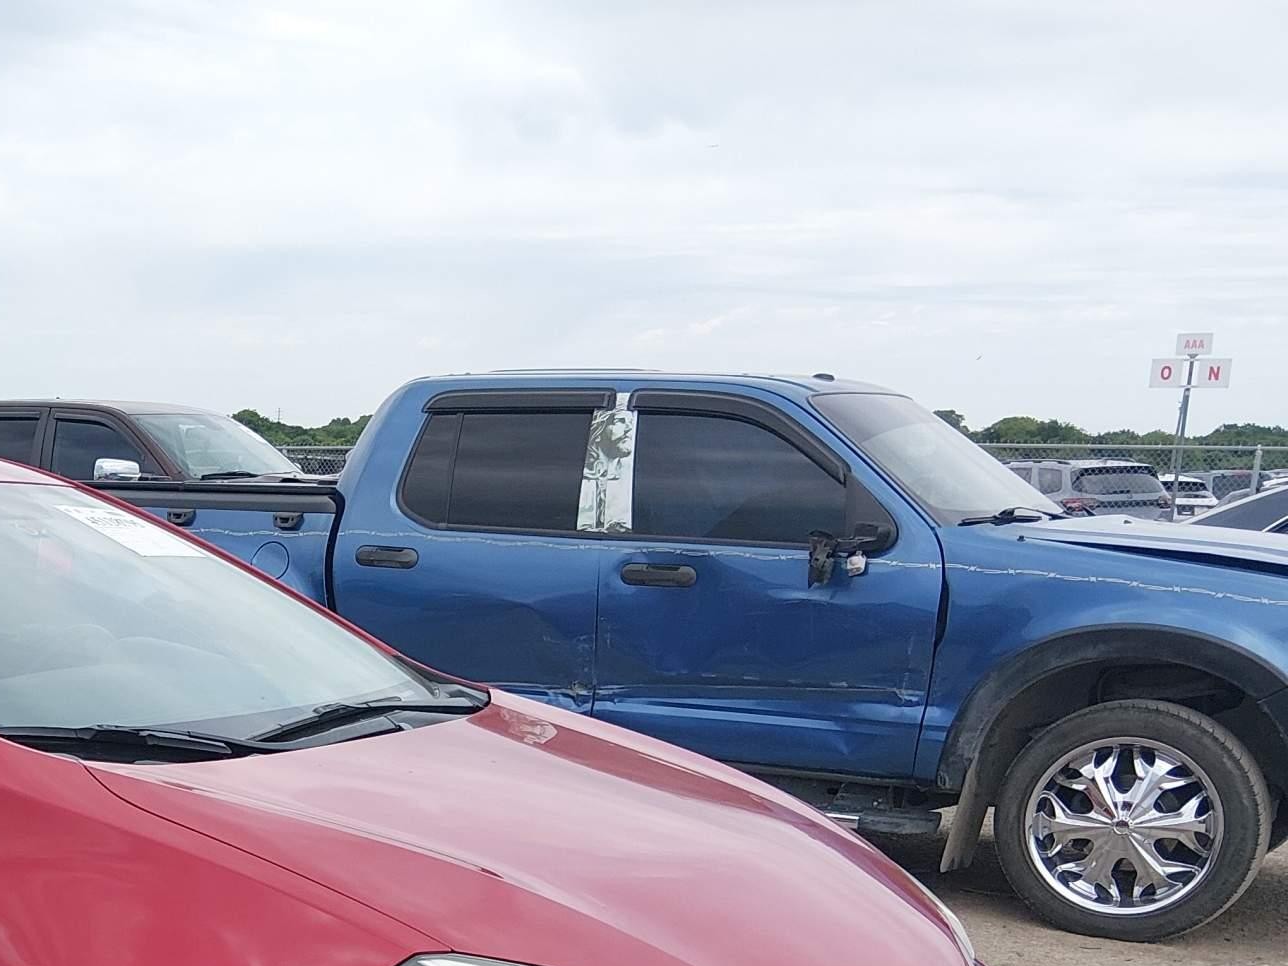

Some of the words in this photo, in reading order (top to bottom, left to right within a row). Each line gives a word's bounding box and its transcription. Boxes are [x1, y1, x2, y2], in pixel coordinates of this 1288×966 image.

[1184, 339, 1205, 350] AAA
[1160, 365, 1172, 381] O
[1208, 366, 1221, 381] N
